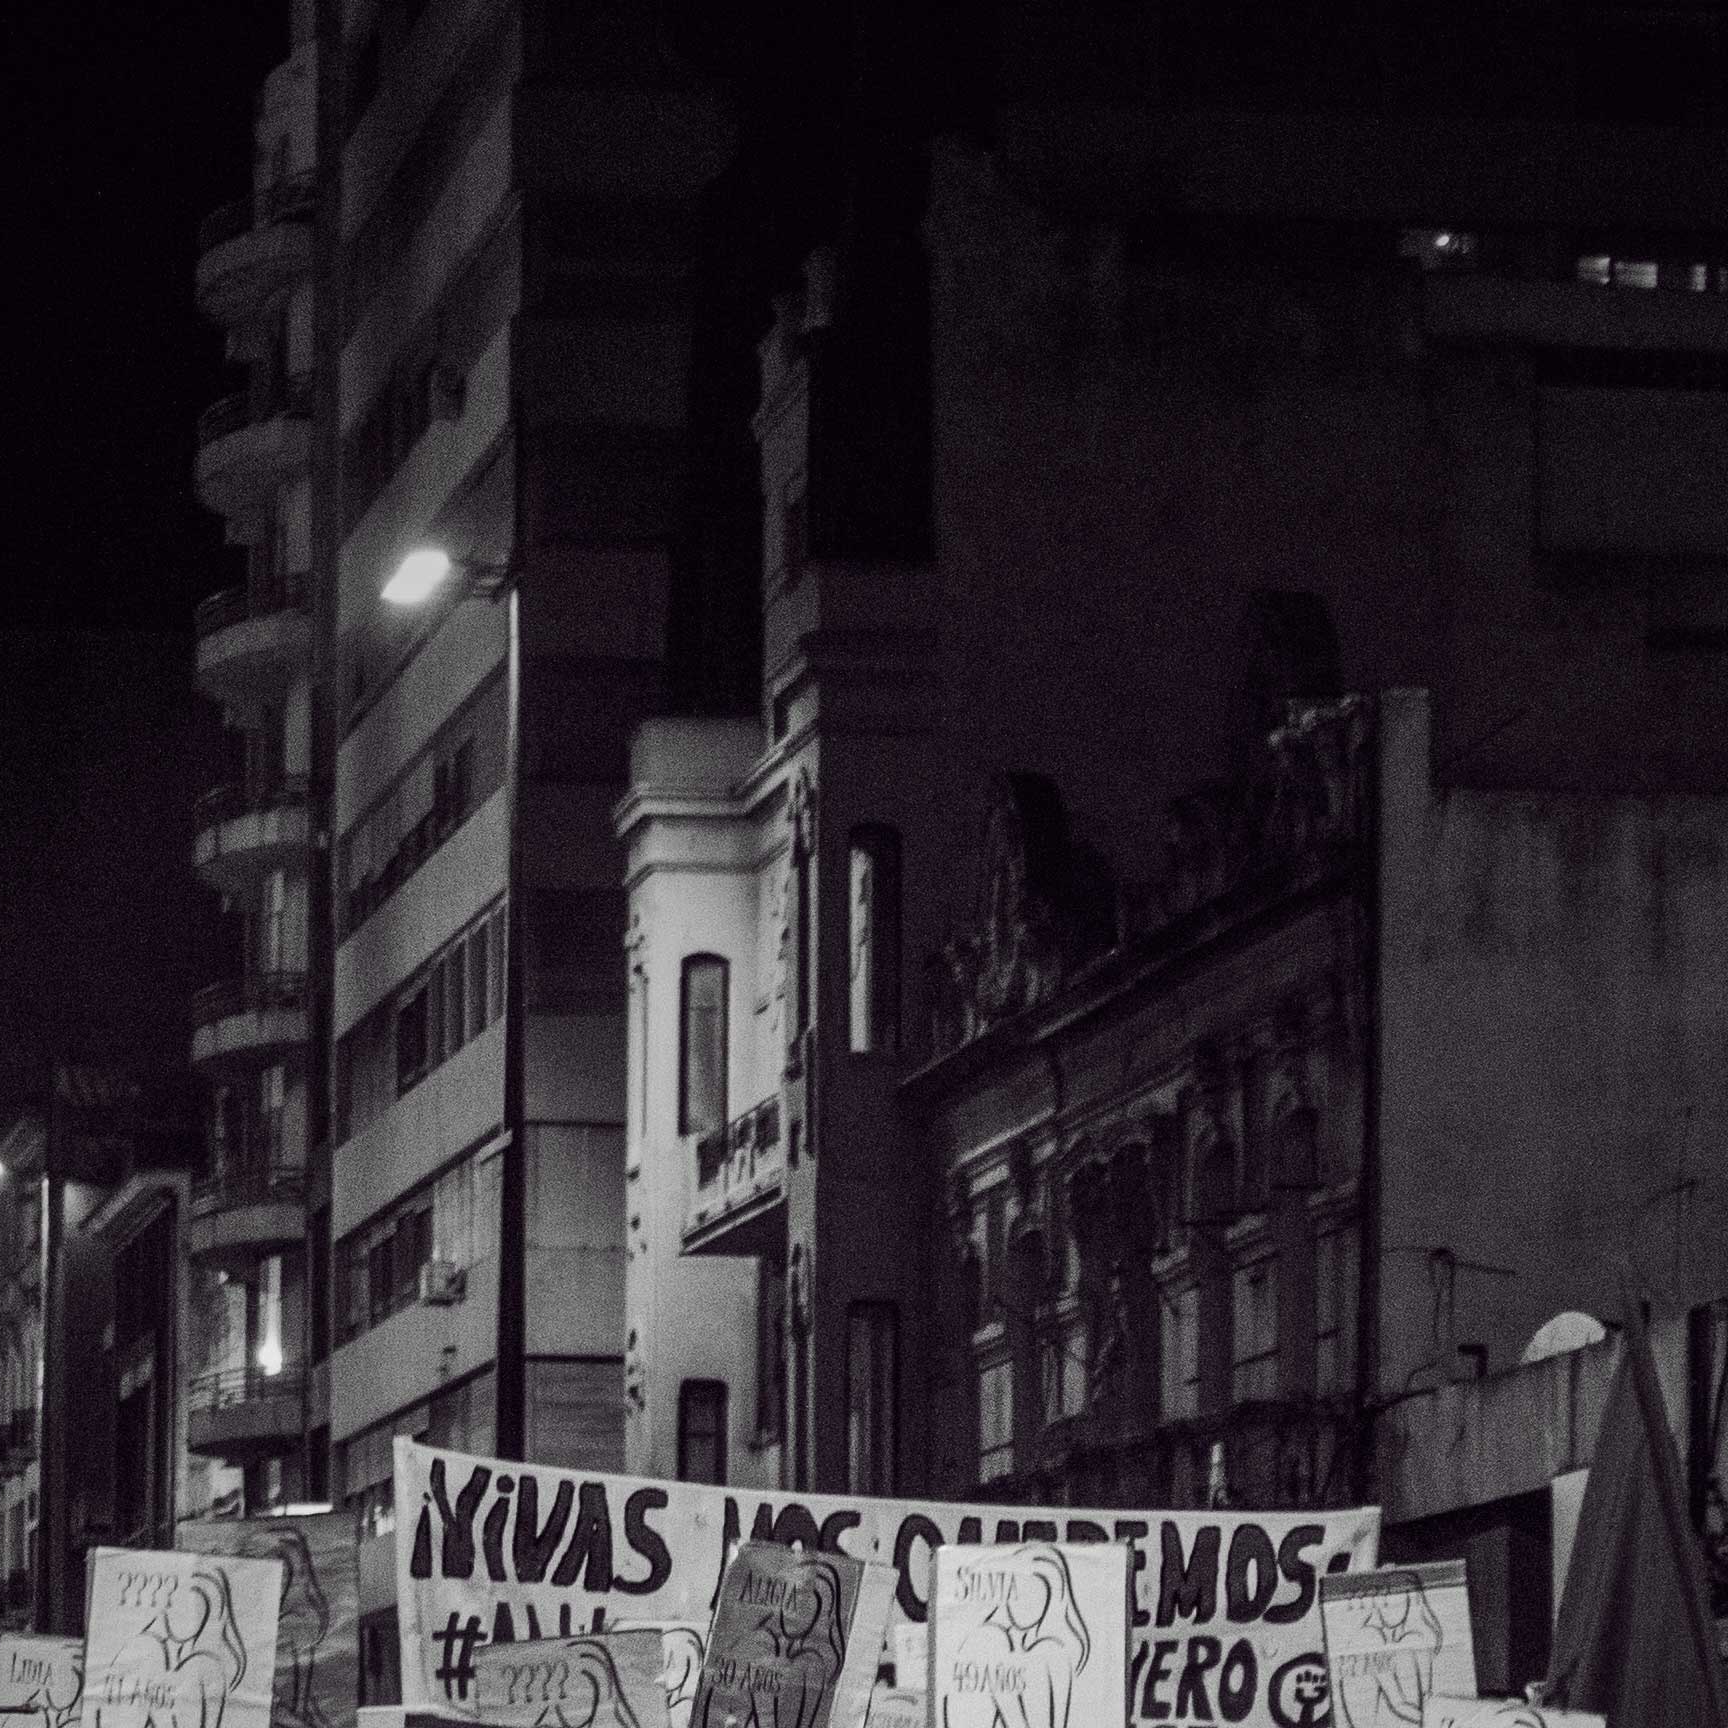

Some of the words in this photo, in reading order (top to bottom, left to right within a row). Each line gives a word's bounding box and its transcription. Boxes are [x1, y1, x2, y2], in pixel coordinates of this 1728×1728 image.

[117, 1569, 180, 1609] ????
[953, 1564, 1019, 1603] SILVIA
[501, 1660, 571, 1705] ????
